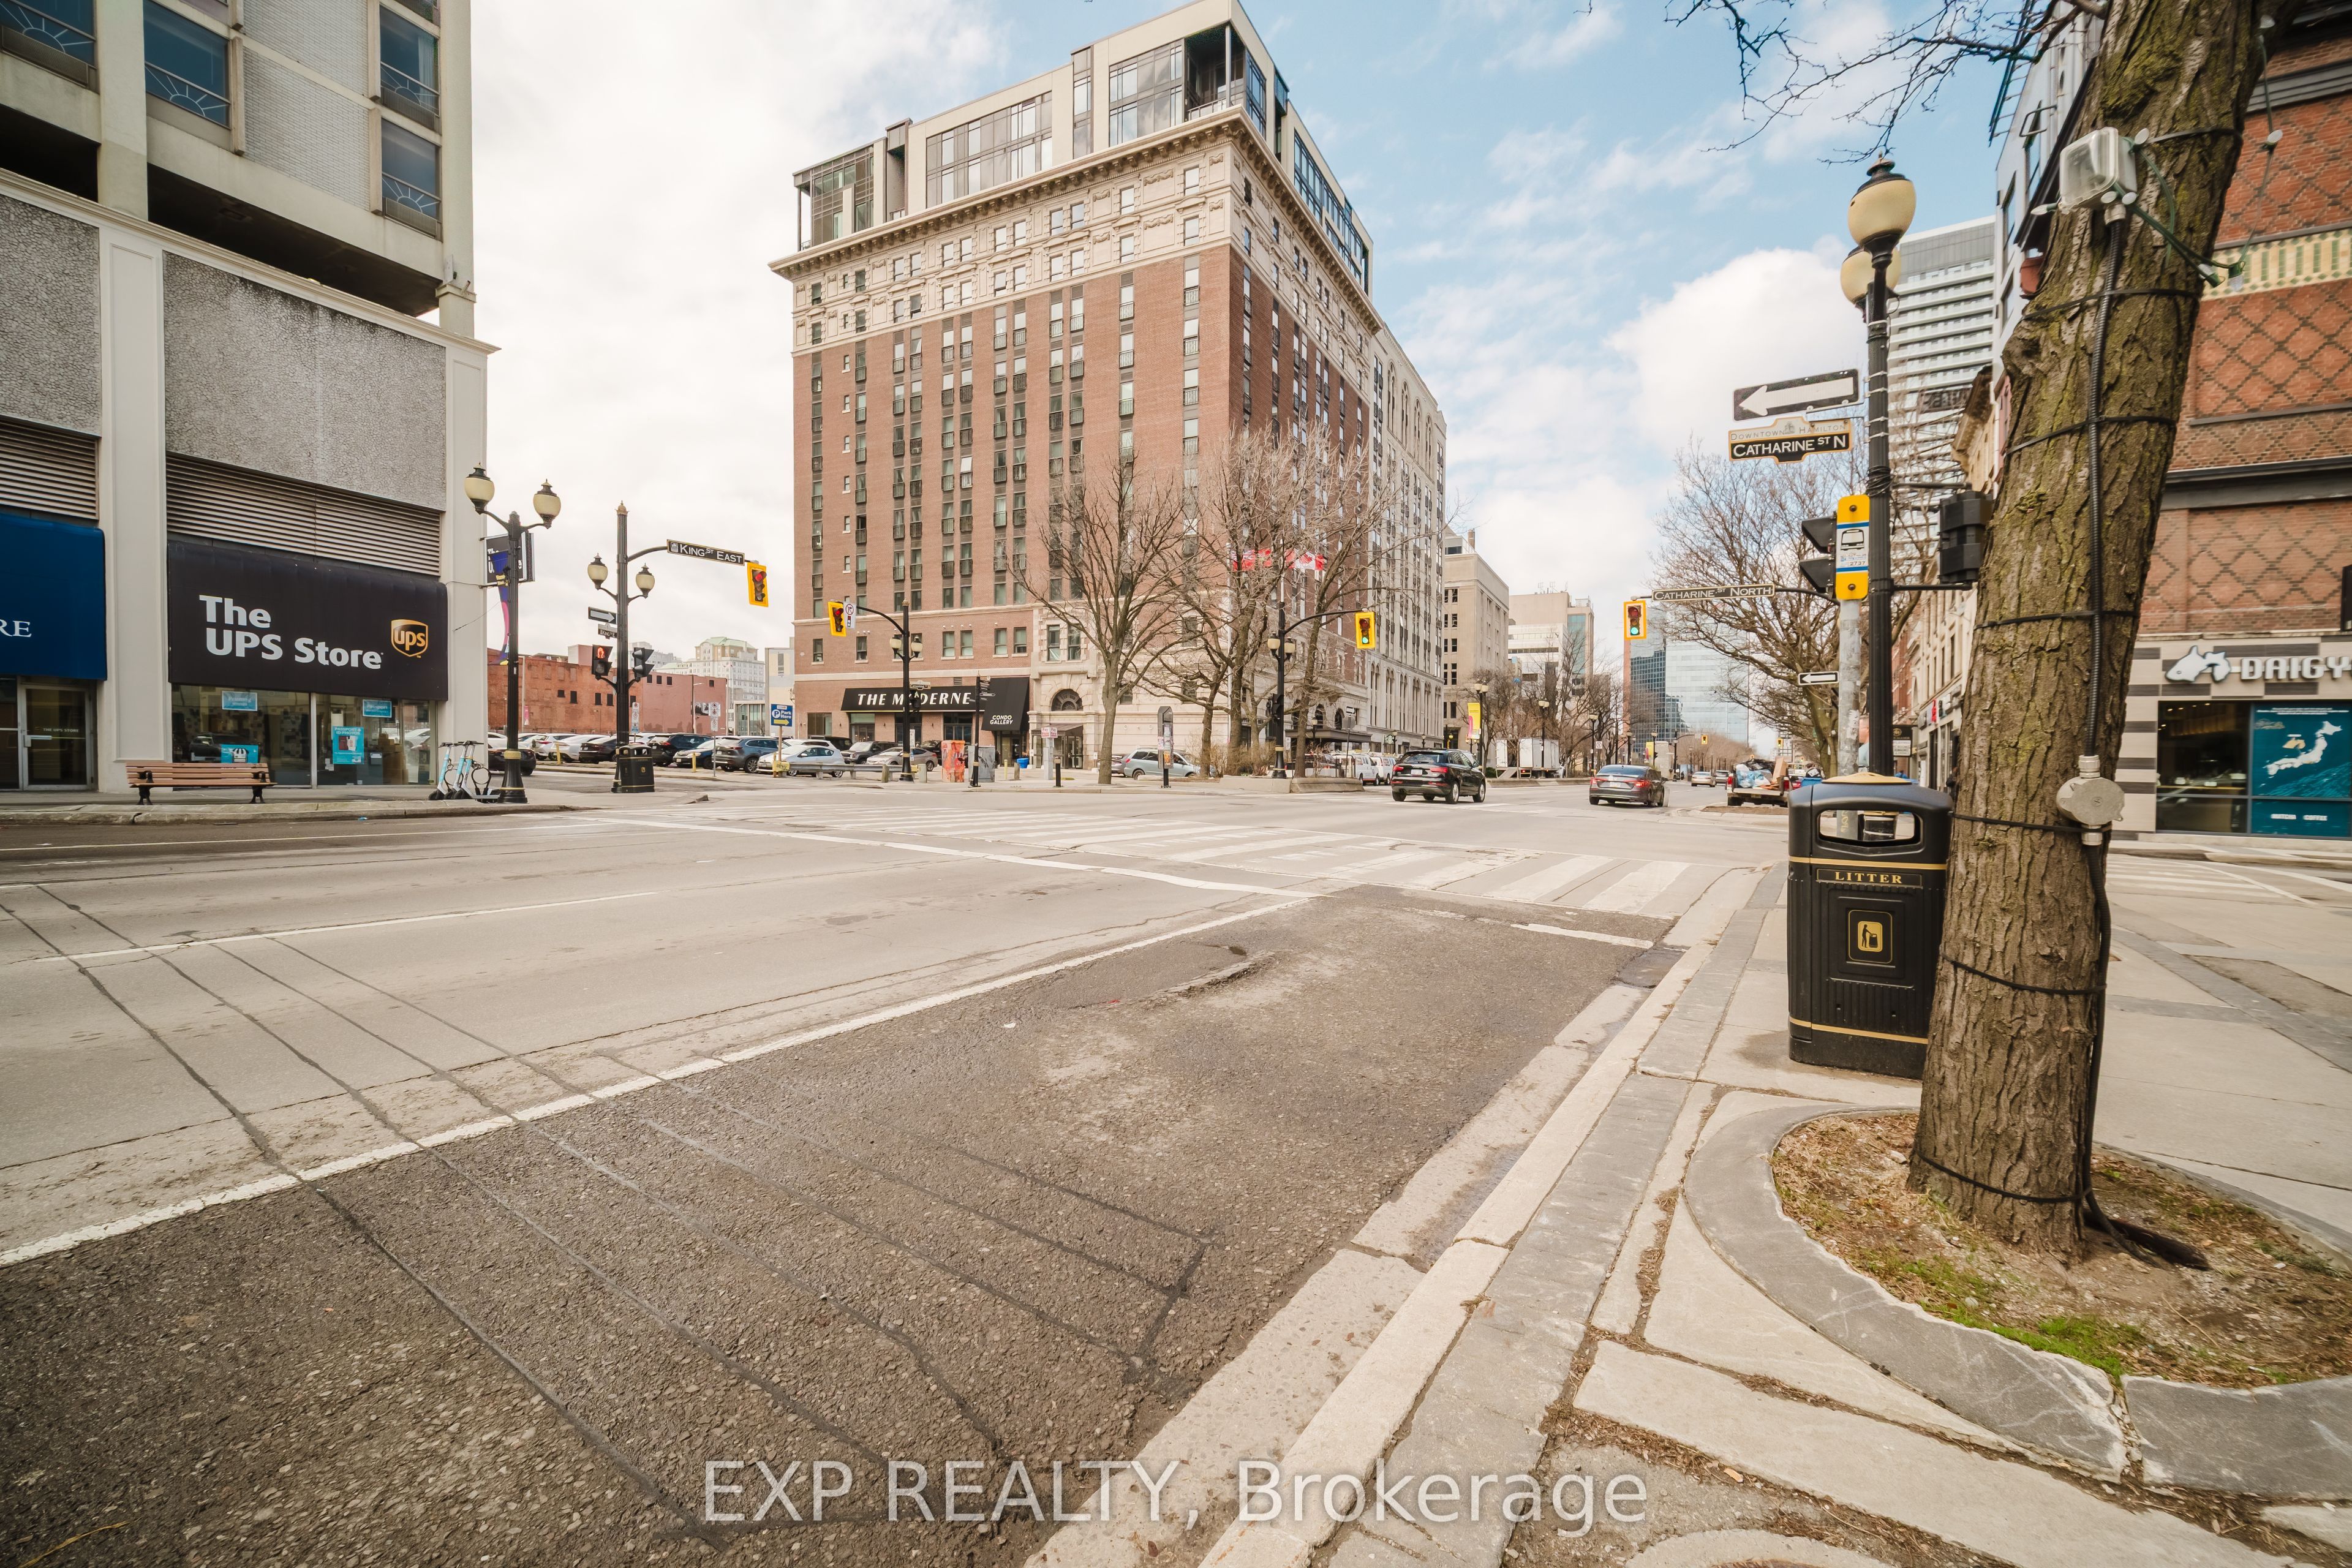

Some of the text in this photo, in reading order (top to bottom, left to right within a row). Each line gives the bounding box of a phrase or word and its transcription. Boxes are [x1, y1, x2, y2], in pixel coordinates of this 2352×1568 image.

[1731, 424, 1845, 441] DOWNTOWN HAMILTON
[1733, 435, 1846, 457] CATHARINE ST N
[680, 543, 705, 557] KING
[717, 551, 742, 563] EAST
[1654, 590, 1715, 600] CATHARINE
[1730, 587, 1773, 597] NORTH
[199, 595, 271, 628] The
[206, 628, 382, 669] UPS Store
[394, 630, 426, 651] ups
[2241, 656, 2352, 680] DAIGY
[858, 692, 972, 706] THE MDERNE
[1835, 871, 1902, 884] LITTER
